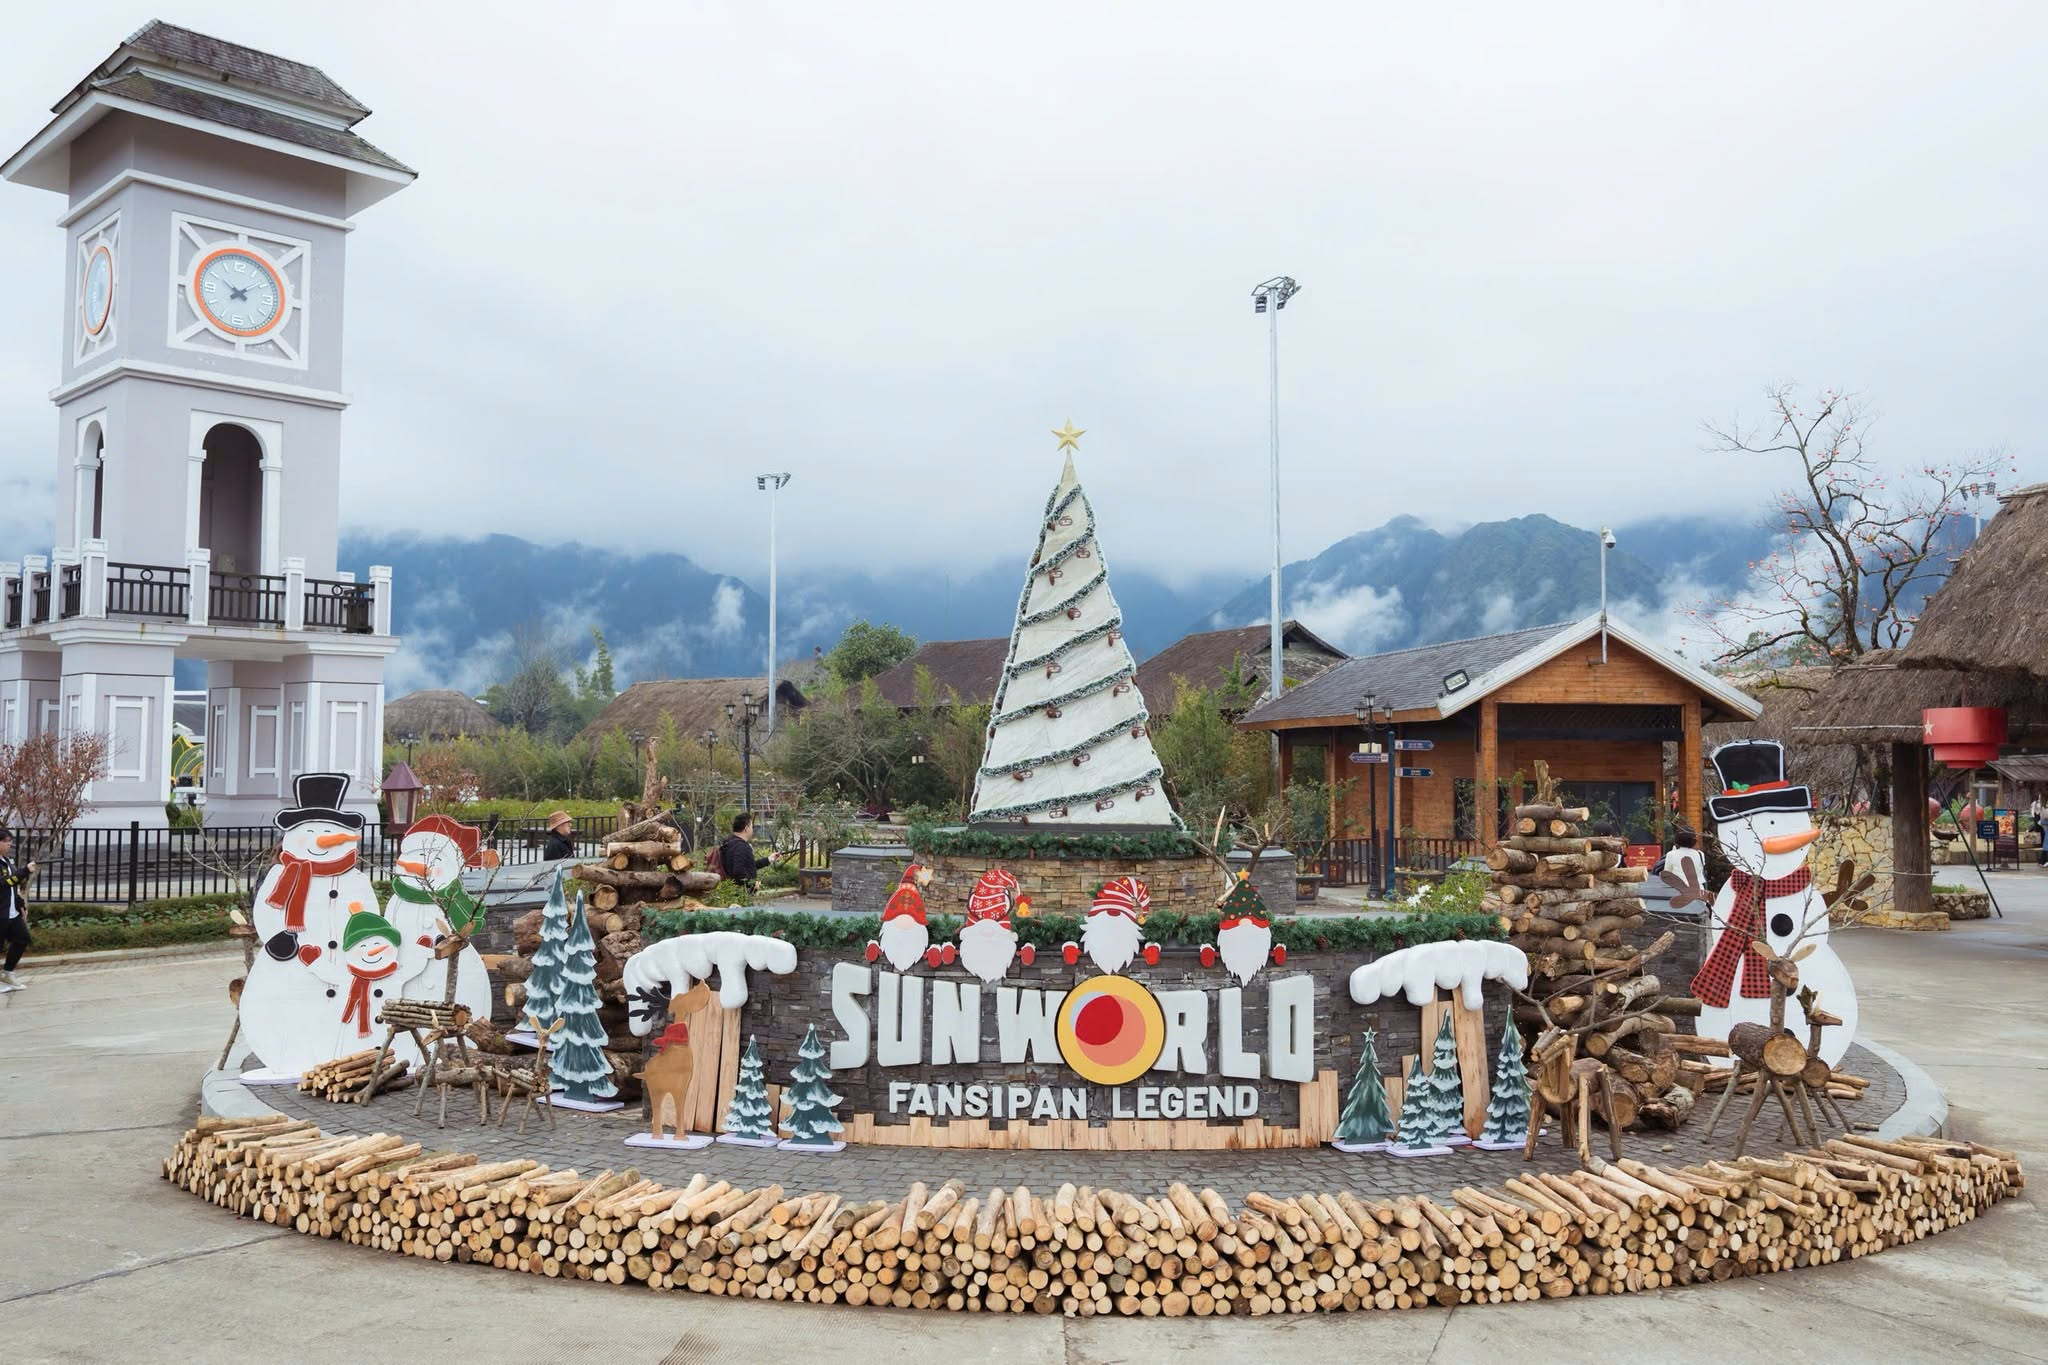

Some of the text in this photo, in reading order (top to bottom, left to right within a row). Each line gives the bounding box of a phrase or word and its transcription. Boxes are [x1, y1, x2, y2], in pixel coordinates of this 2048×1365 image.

[234, 261, 247, 273] 12
[204, 281, 216, 293] 9
[261, 294, 273, 306] 3
[231, 314, 243, 326] 6
[830, 962, 981, 1070] SUN
[888, 1080, 1260, 1120] FANSIPAN LEGEND
